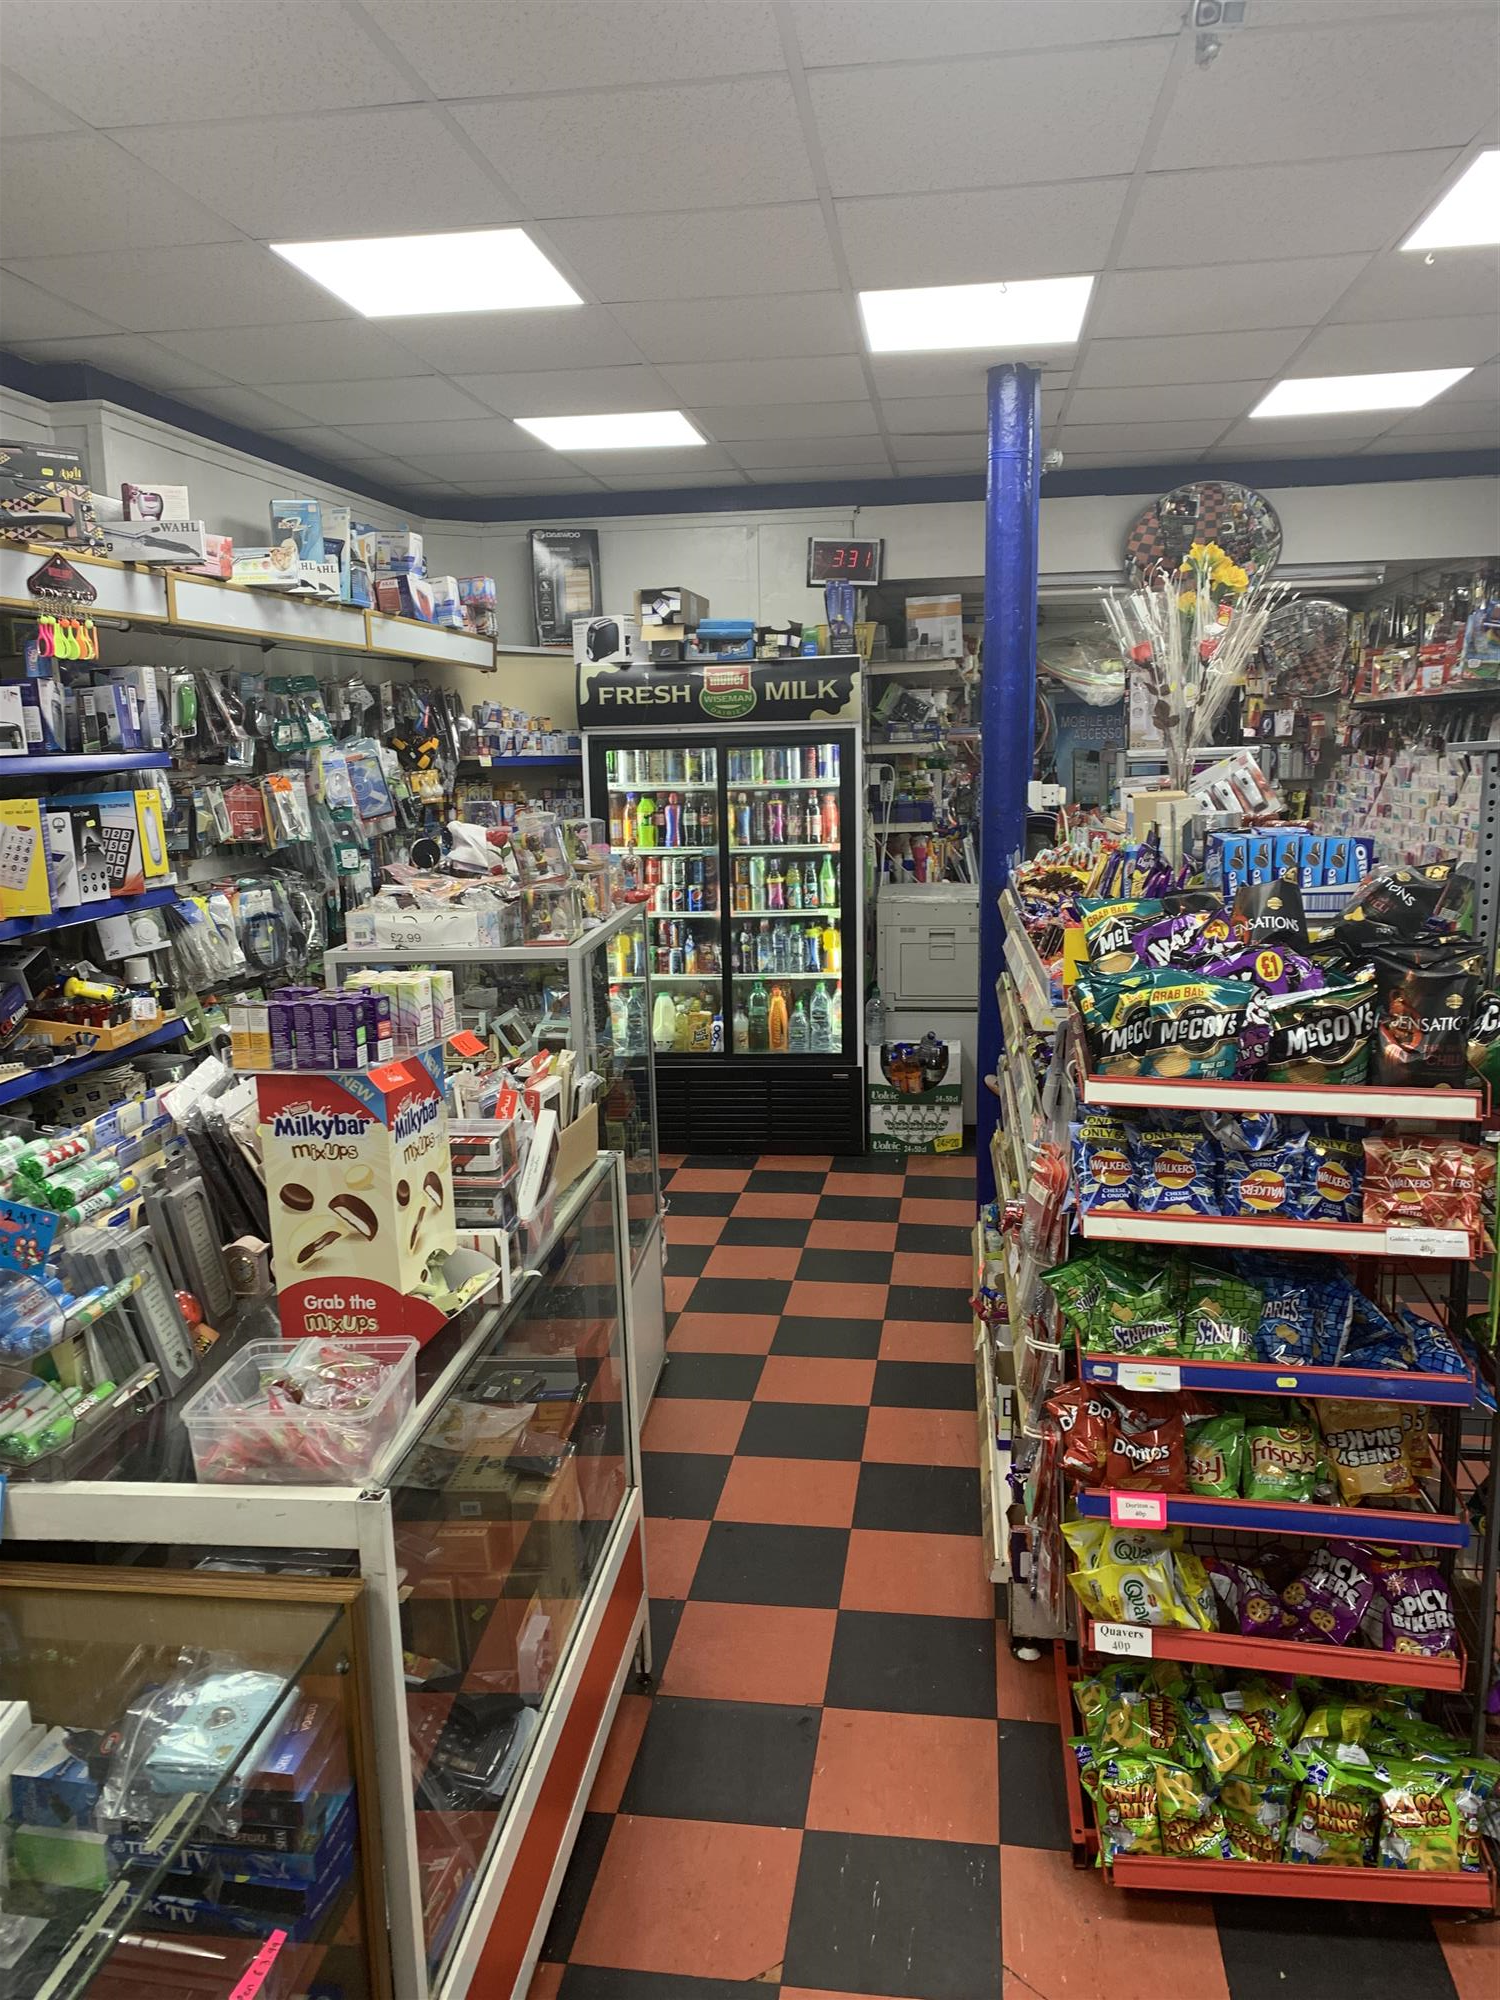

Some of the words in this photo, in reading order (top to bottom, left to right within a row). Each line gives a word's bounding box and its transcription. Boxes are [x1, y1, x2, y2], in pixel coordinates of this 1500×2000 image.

[160, 522, 199, 533] WAHL
[301, 561, 316, 571] HL
[317, 564, 337, 574] AHL
[598, 685, 691, 705] FRESH
[765, 679, 839, 701] MILK
[704, 694, 752, 704] WISEMAN
[1060, 715, 1103, 728] MOBILE
[1074, 727, 1124, 741] ACCESSO
[1355, 844, 1368, 878] ORE
[1087, 908, 1109, 928] GRAB
[1110, 904, 1128, 917] BAG
[1233, 916, 1299, 938] ENSATIONS
[391, 932, 422, 943] £2.99
[1261, 954, 1279, 978] £1
[1152, 988, 1181, 1002] GRAB
[1184, 986, 1205, 998] BAG
[339, 1075, 375, 1102] NEW
[274, 1114, 371, 1140] Milkybar
[395, 1099, 440, 1143] Milkybar
[1081, 1129, 1113, 1138] ONLY
[1091, 1160, 1132, 1172] WALKERS
[1154, 1161, 1195, 1174] WALKERS
[1317, 1171, 1352, 1189] WALKERS
[1389, 1179, 1432, 1189] WALKERS
[1240, 1184, 1286, 1199] WALKERS
[304, 1294, 345, 1310] Grab
[349, 1294, 377, 1310] the
[1113, 1322, 1172, 1350] SQUARES
[1326, 1427, 1403, 1451] SNAKES
[1310, 1548, 1367, 1585] SPICY
[1394, 1589, 1448, 1616] SPICY
[1391, 1609, 1455, 1633] BIKERS
[1100, 1625, 1144, 1639] Quavers
[1112, 1640, 1131, 1653] 40p
[1305, 1791, 1363, 1820] ONION
[1316, 1813, 1360, 1833] RING
[181, 1850, 211, 1870] TV
[166, 1903, 198, 1924] TV
